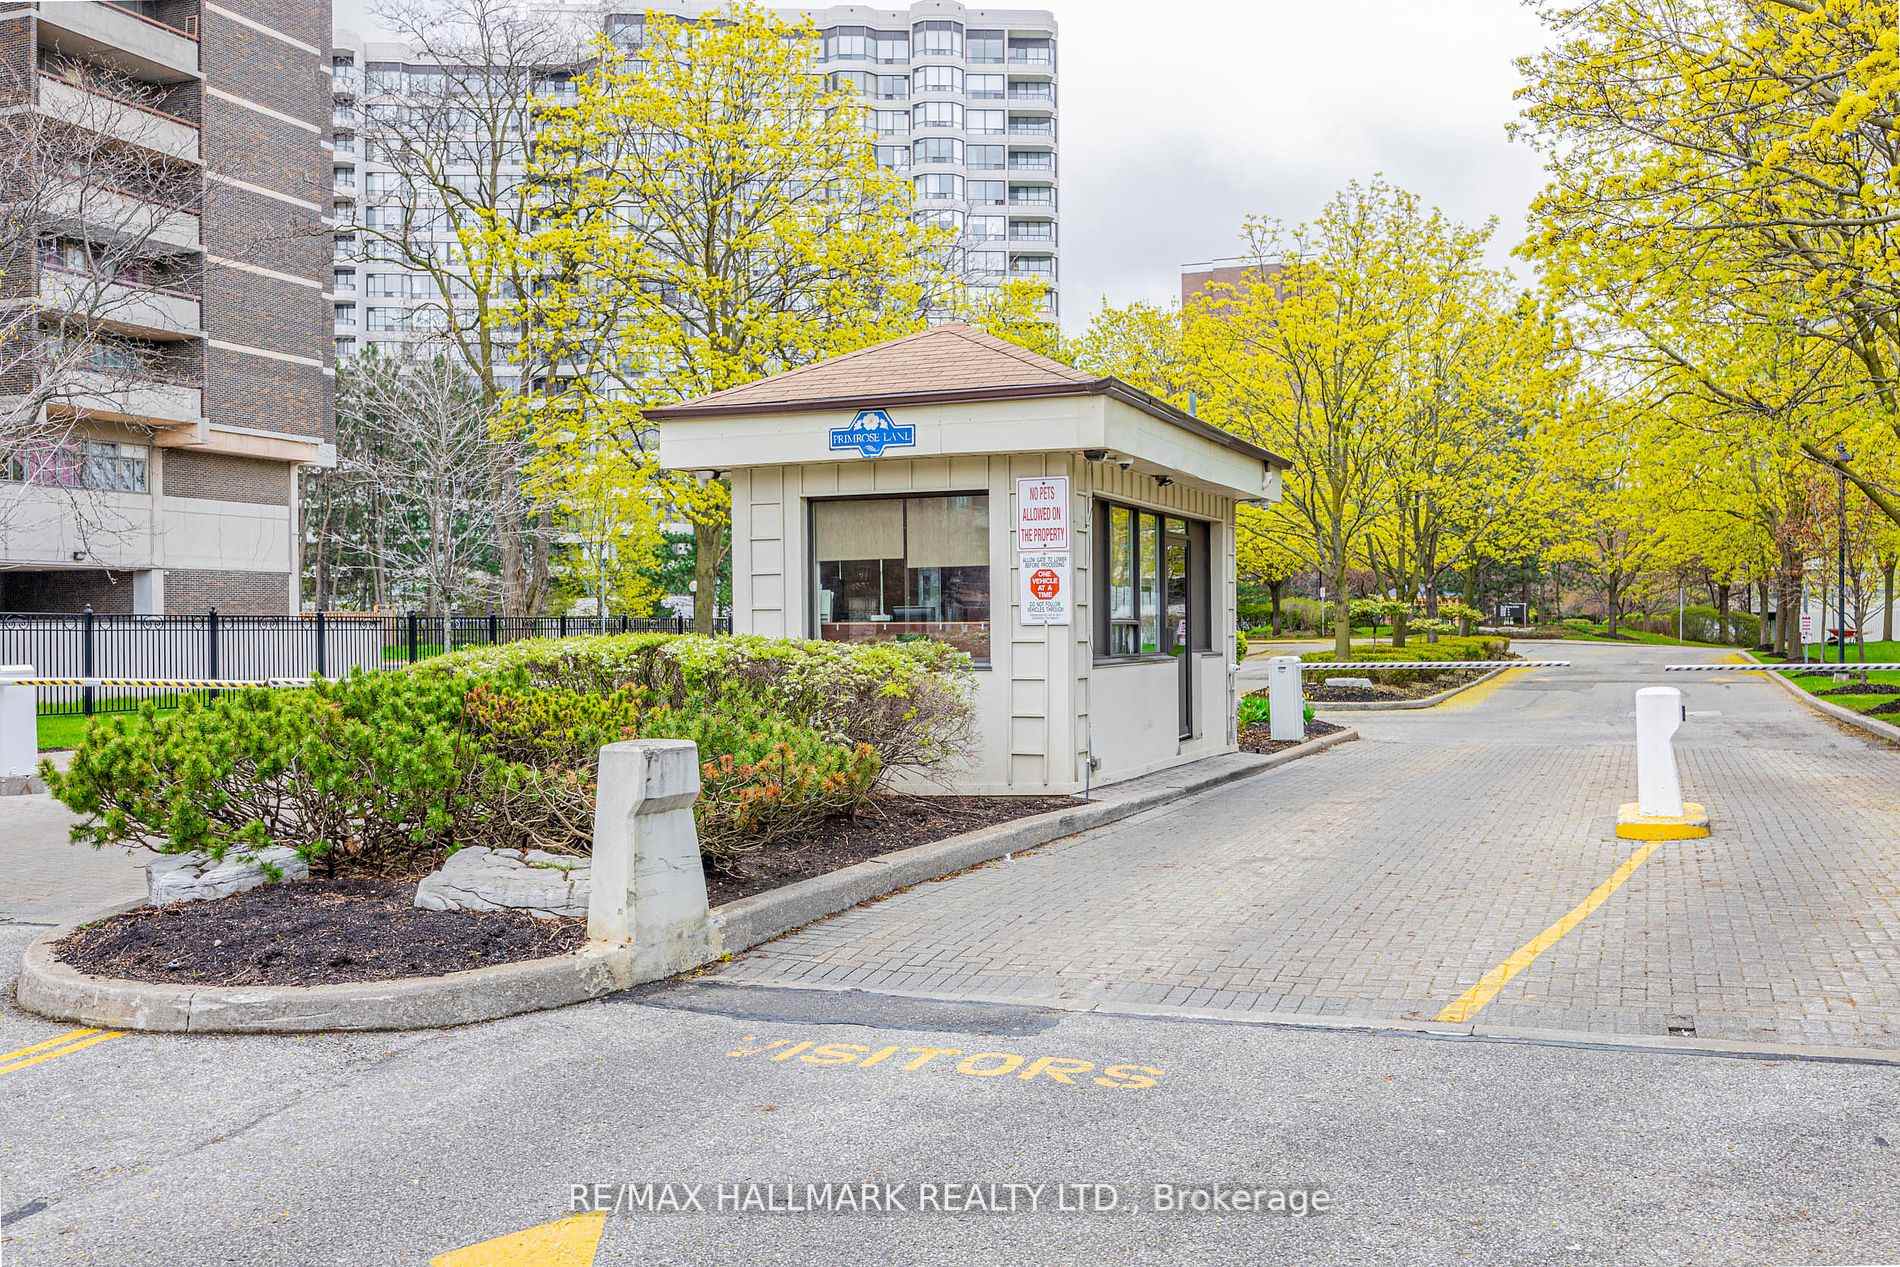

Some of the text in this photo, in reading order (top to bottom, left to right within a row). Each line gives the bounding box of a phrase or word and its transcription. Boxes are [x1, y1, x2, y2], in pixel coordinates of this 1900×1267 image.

[833, 433, 880, 444] PRIMROSE
[1029, 486, 1055, 500] NO PETS
[1022, 506, 1061, 521] ALLOWED ON
[1021, 527, 1064, 542] THE PROPERTY
[726, 1034, 1166, 1090] VISITORS
